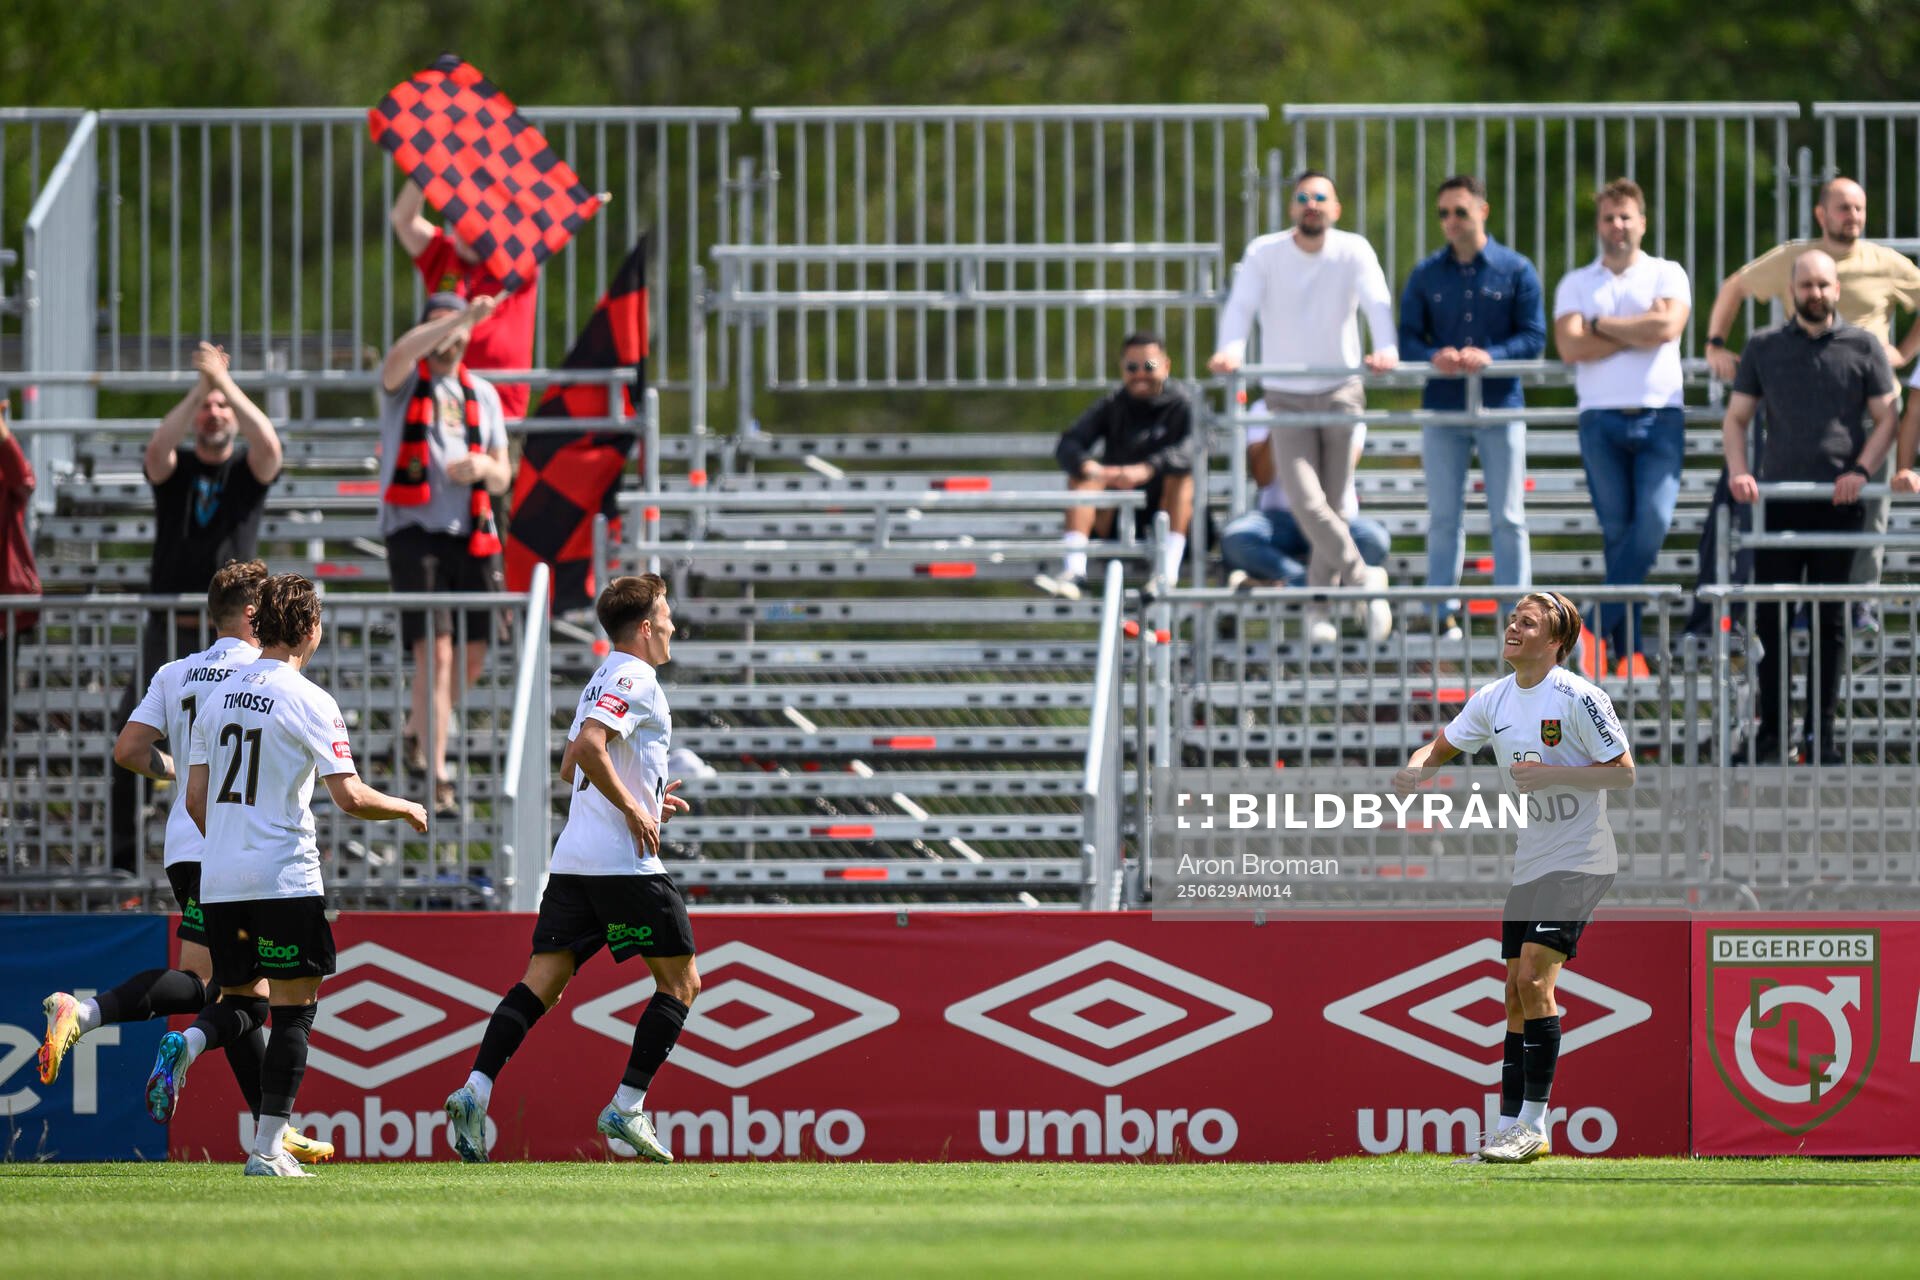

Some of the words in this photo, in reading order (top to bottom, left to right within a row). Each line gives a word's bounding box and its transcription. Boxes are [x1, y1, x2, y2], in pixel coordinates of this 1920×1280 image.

[182, 667, 238, 687] JAKOBSE
[223, 691, 275, 714] TIMOSSI
[600, 695, 627, 712] UNIBET
[1581, 695, 1617, 748] stadium
[216, 723, 263, 806] 21
[1510, 791, 1579, 823] ÖJD
[607, 926, 653, 941] coop
[258, 945, 299, 960] coop
[1719, 939, 1868, 958] DEGERFORS
[978, 1094, 1239, 1156] umbro
